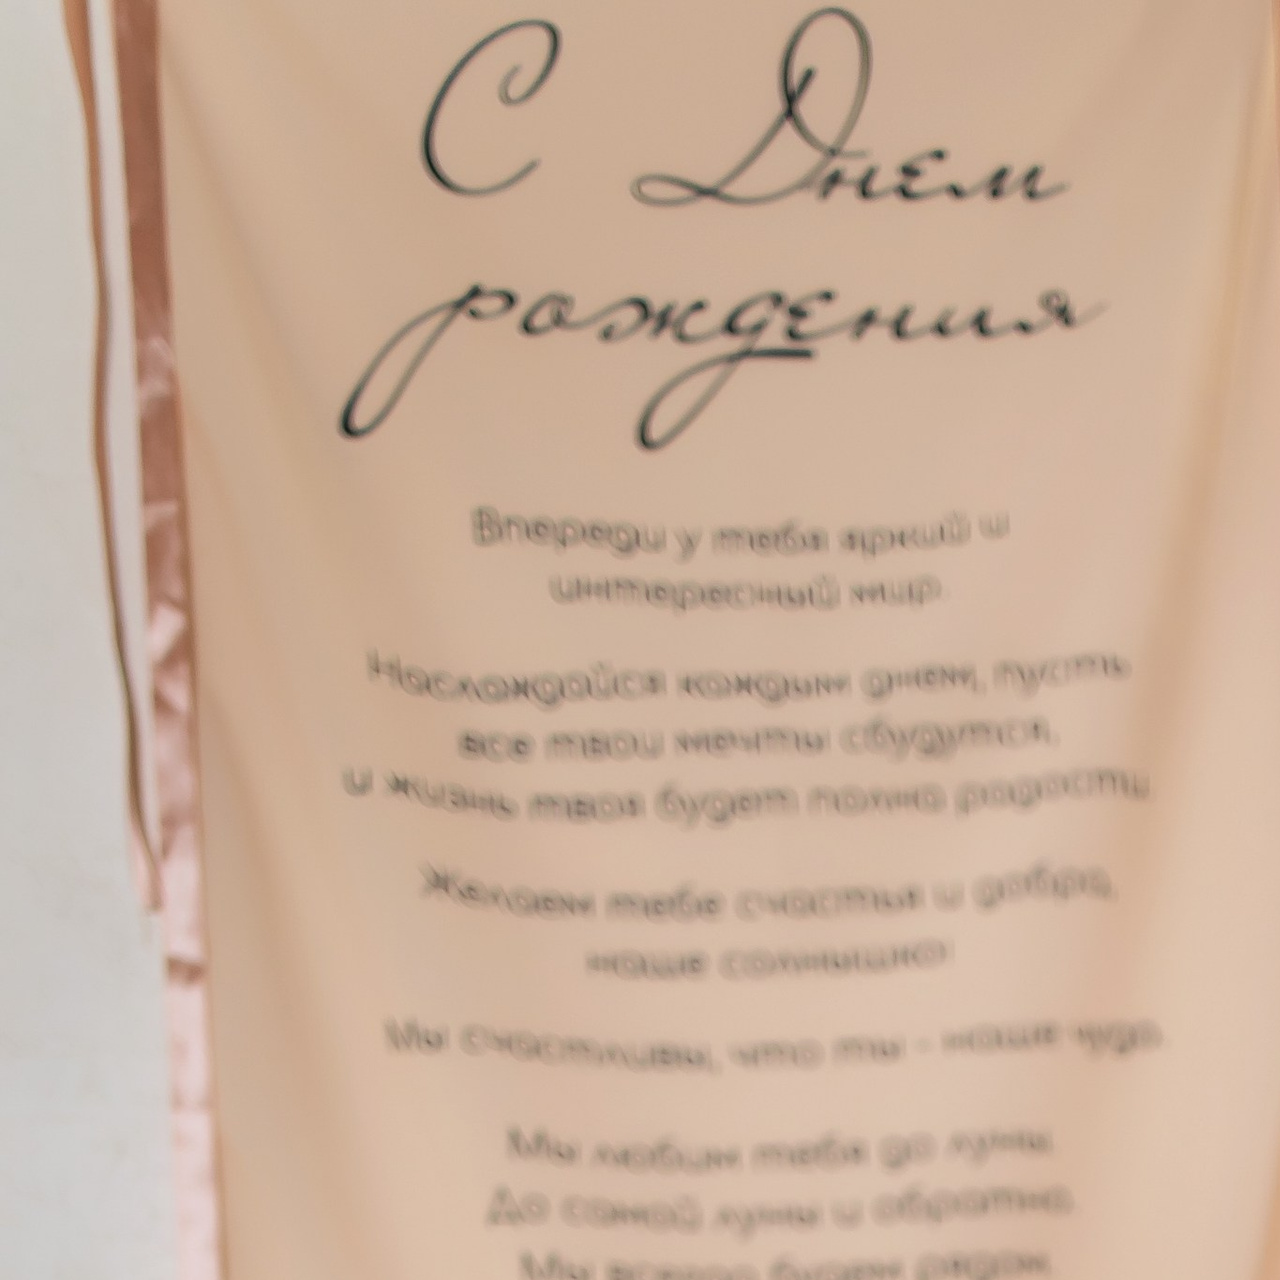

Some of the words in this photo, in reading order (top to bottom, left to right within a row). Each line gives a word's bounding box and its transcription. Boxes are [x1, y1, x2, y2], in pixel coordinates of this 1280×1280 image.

[421, 18, 561, 198] С
[631, 6, 1072, 207] Днем
[339, 283, 1112, 452] рождения
[471, 505, 667, 558] Впереди
[712, 518, 829, 556] тебя
[838, 511, 971, 561] яркий
[550, 574, 841, 614] интересный
[366, 648, 666, 711] Наслаждайся
[677, 670, 851, 708] каждым
[992, 653, 1132, 699] пусть
[457, 729, 536, 763] все
[545, 730, 665, 761] твои
[674, 727, 831, 758] мечты
[385, 770, 519, 822] жизнь
[527, 792, 646, 824] твоя
[654, 778, 800, 830] будет
[418, 862, 597, 921] Желаем
[604, 881, 726, 923] тебе
[734, 882, 926, 922] счастья
[585, 949, 710, 980] наше
[383, 1014, 450, 1055] Мы
[728, 1038, 825, 1073] что
[831, 1035, 906, 1067] ты
[506, 1123, 583, 1168] Мы
[590, 1135, 743, 1176] любим
[877, 1132, 938, 1174] до
[560, 1194, 703, 1235] самой
[711, 1202, 824, 1244] луны
